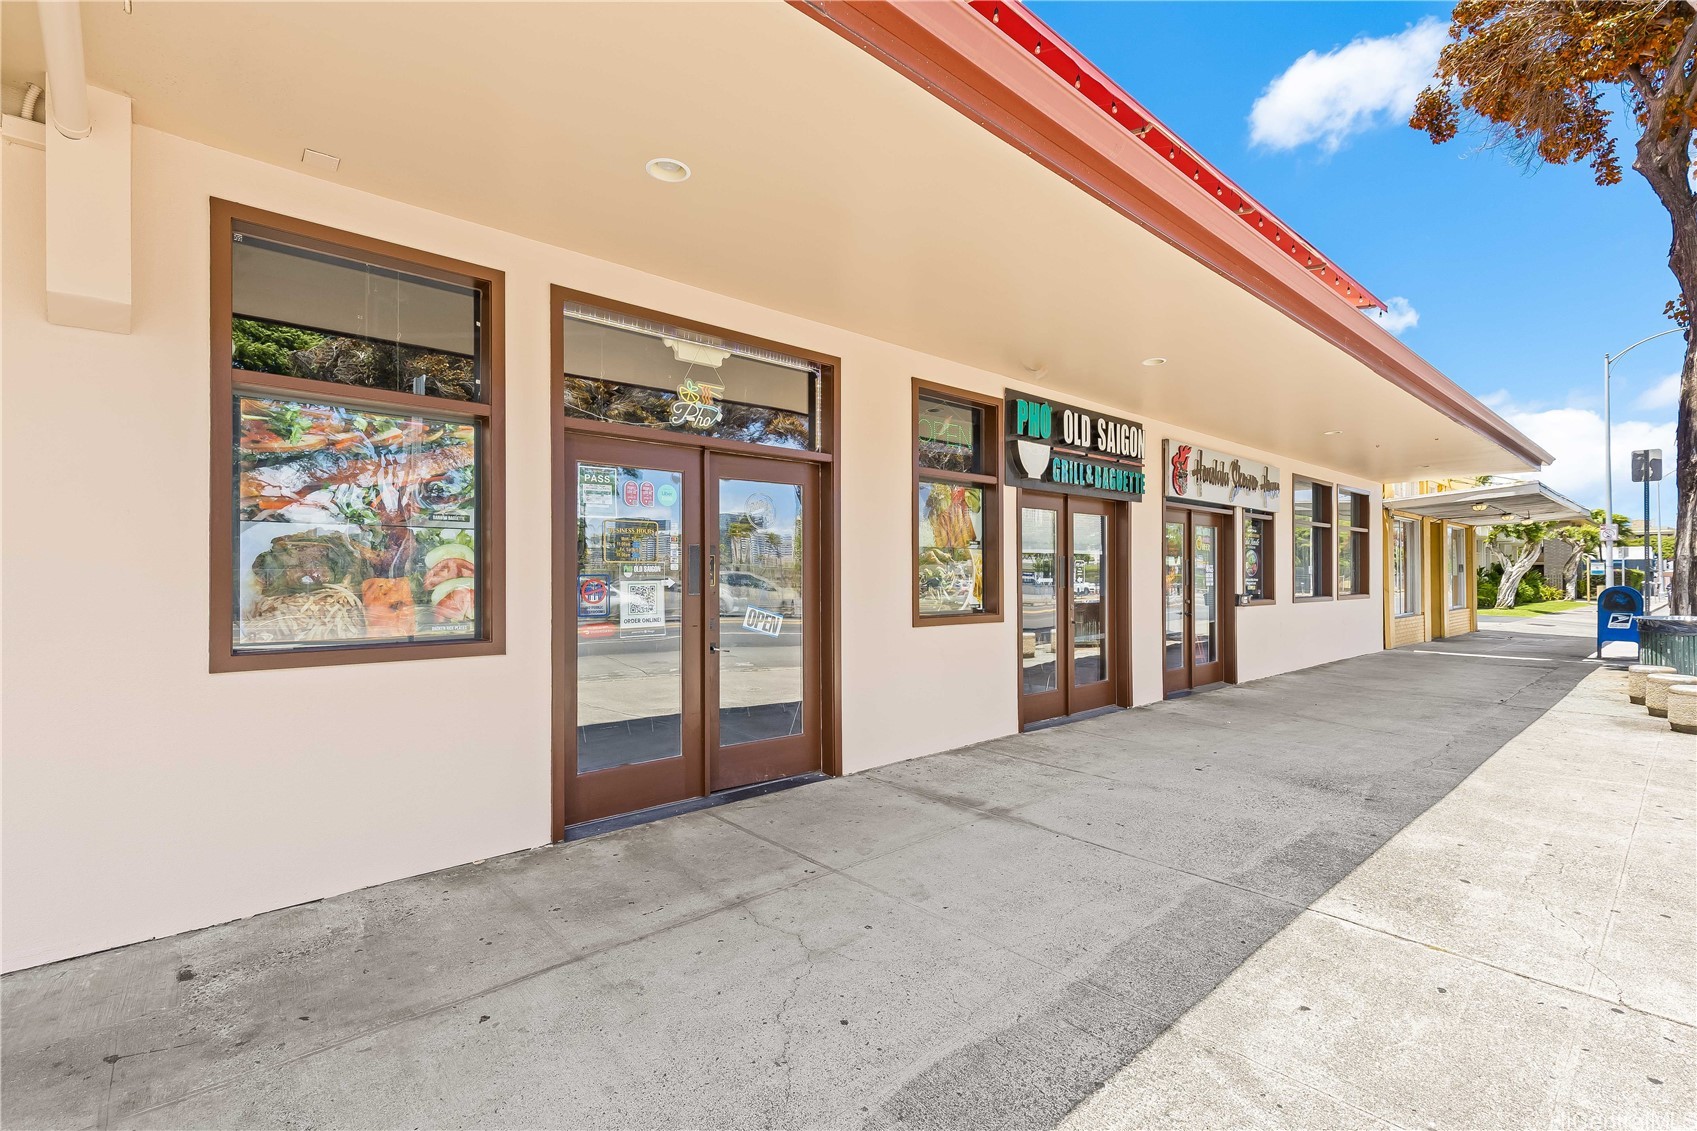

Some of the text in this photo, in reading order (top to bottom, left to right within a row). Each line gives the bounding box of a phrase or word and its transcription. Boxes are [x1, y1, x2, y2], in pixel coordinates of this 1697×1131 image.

[671, 401, 711, 427] Pho
[918, 418, 972, 451] OPEN
[1063, 409, 1091, 448] OLD
[1097, 418, 1146, 459] SAIGON
[584, 474, 611, 483] PASS
[633, 565, 643, 573] OLD
[643, 565, 662, 573] SAIGON
[747, 609, 780, 634] OPEN
